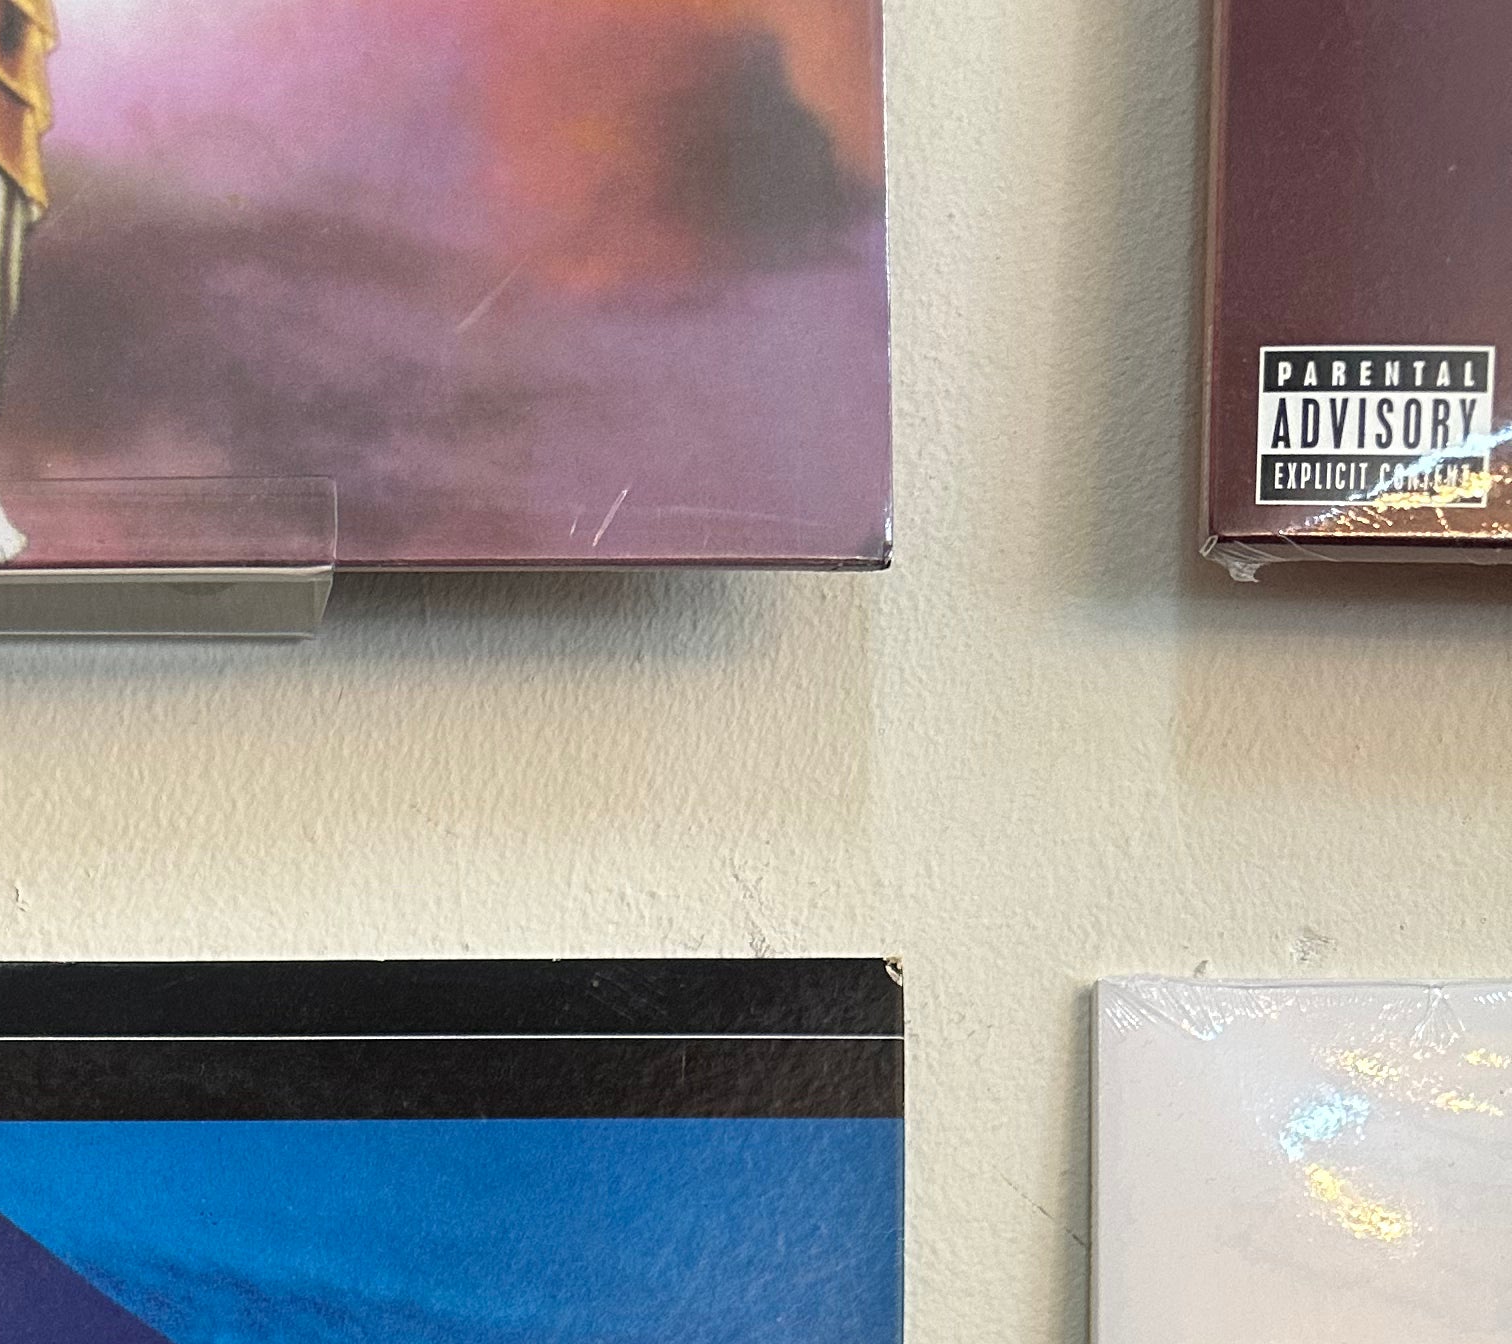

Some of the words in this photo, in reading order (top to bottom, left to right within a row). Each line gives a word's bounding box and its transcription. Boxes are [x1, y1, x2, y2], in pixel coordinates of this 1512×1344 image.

[1277, 360, 1476, 387] PARENTAL
[1271, 397, 1477, 450] ADVISORY
[1274, 462, 1368, 490] EXPLICIT
